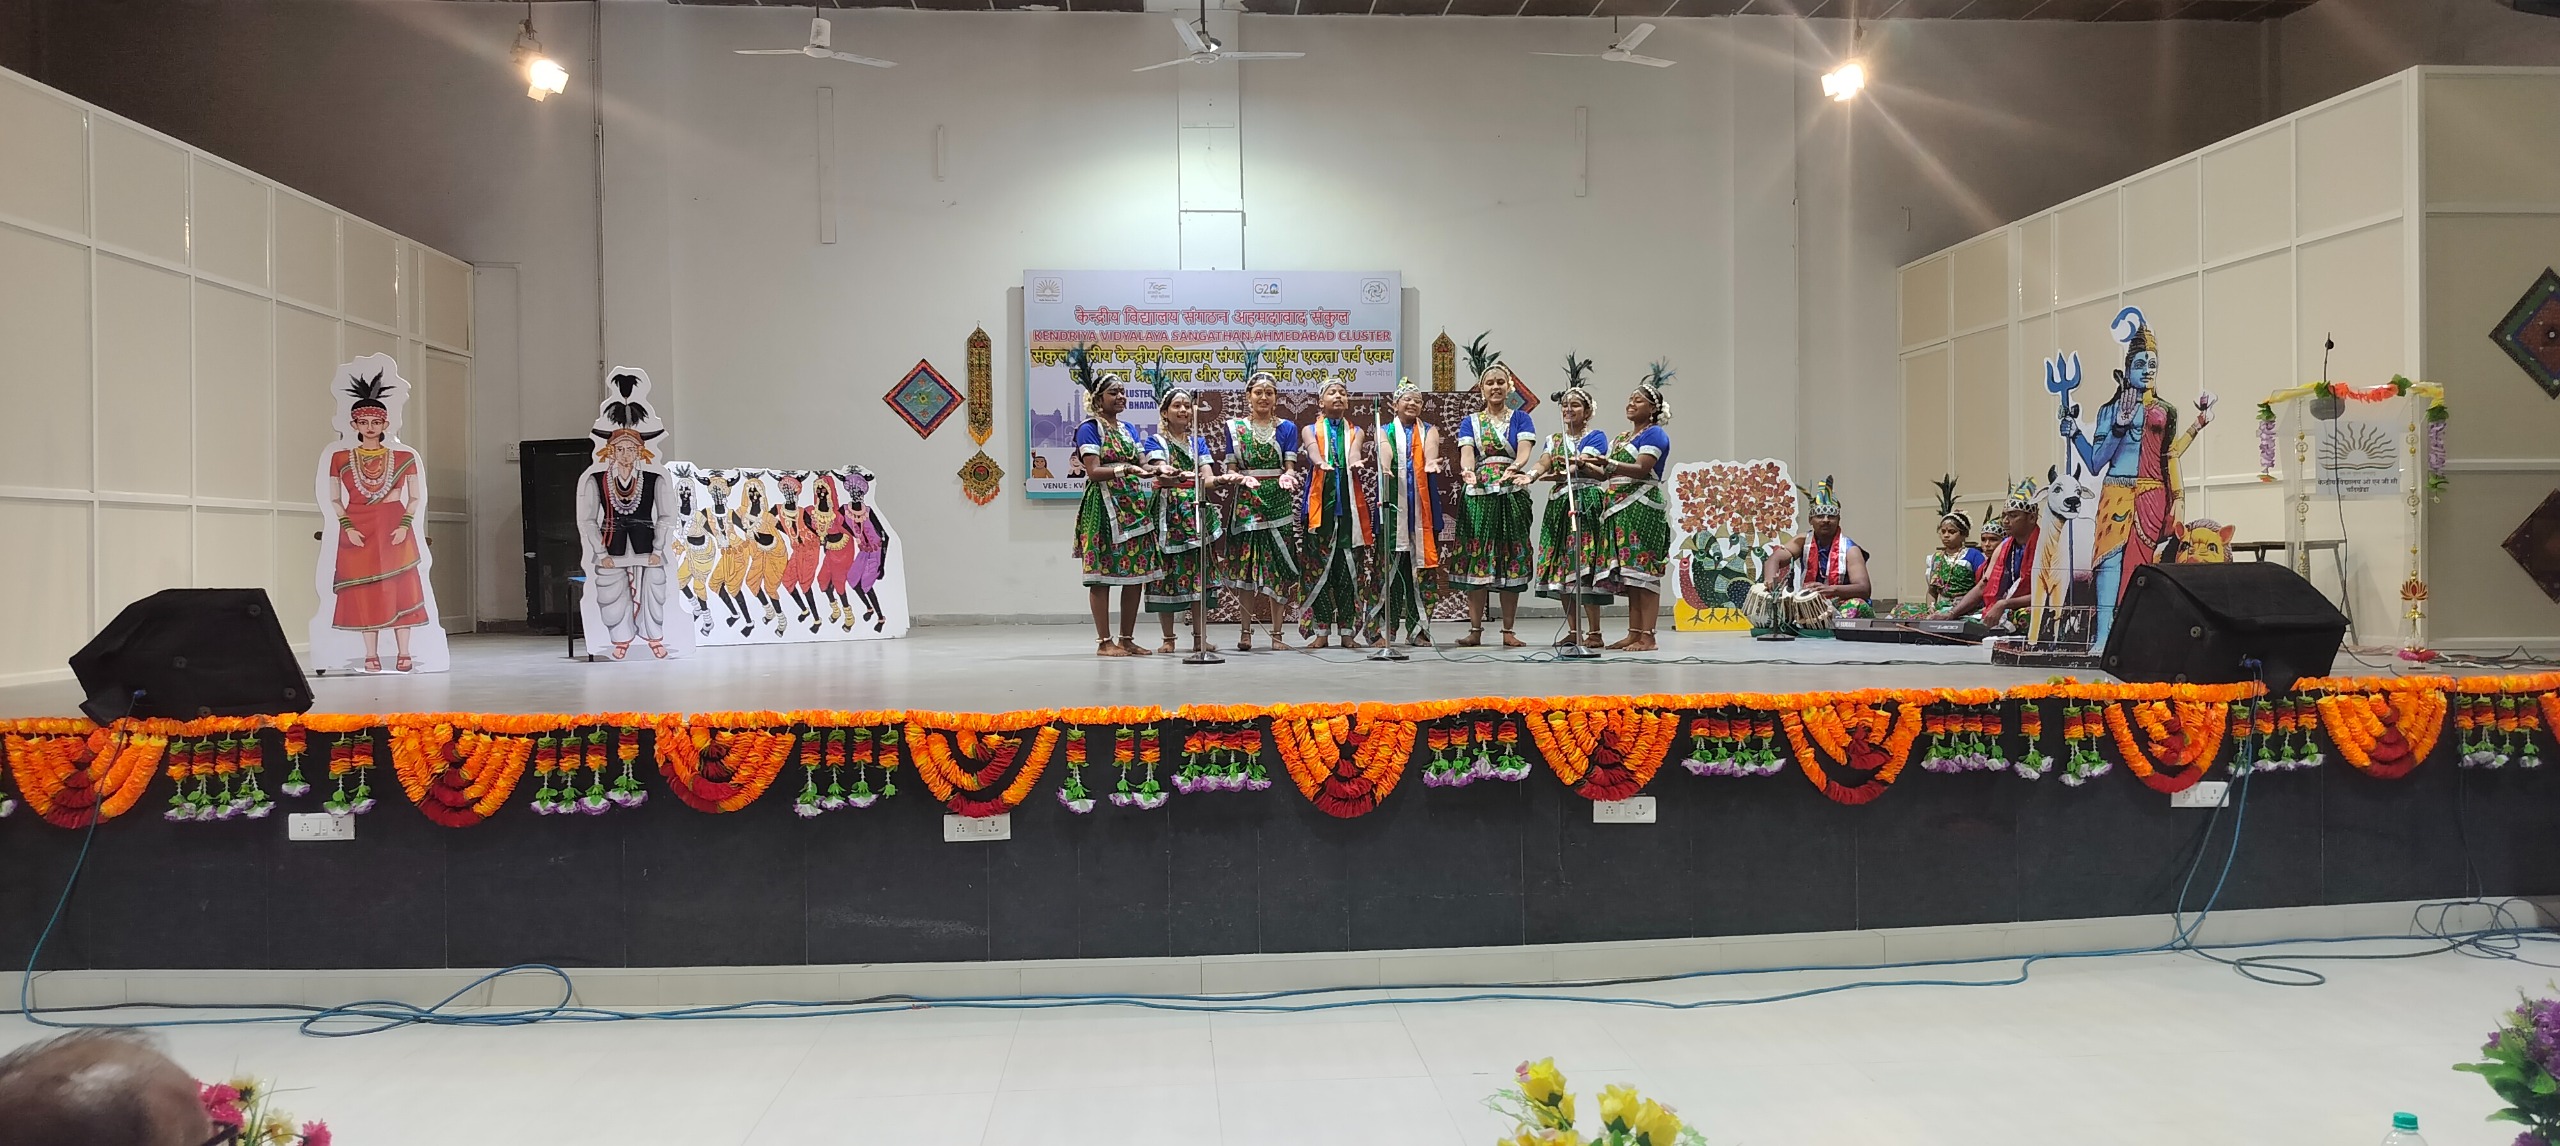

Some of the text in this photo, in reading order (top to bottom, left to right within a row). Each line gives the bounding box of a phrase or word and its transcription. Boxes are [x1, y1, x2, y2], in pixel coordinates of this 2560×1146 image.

[1075, 305, 1350, 329] केन्द्रीय विद्यालय संगठन अहमदाबाद संकुल
[1034, 330, 1096, 342] KENDRIYA
[1099, 330, 1168, 342] VIDYALAYA
[1339, 330, 1391, 342] CLUSTER
[1031, 346, 1070, 366] संकुल
[1115, 345, 1159, 364] केन्द्रीय
[1161, 345, 1213, 364] विद्यालय
[1301, 349, 1339, 365] एकता
[1341, 345, 1362, 363] पर्व
[1364, 349, 1394, 365] एवम
[1195, 363, 1220, 382] और
[1124, 389, 1153, 398] LUSTER
